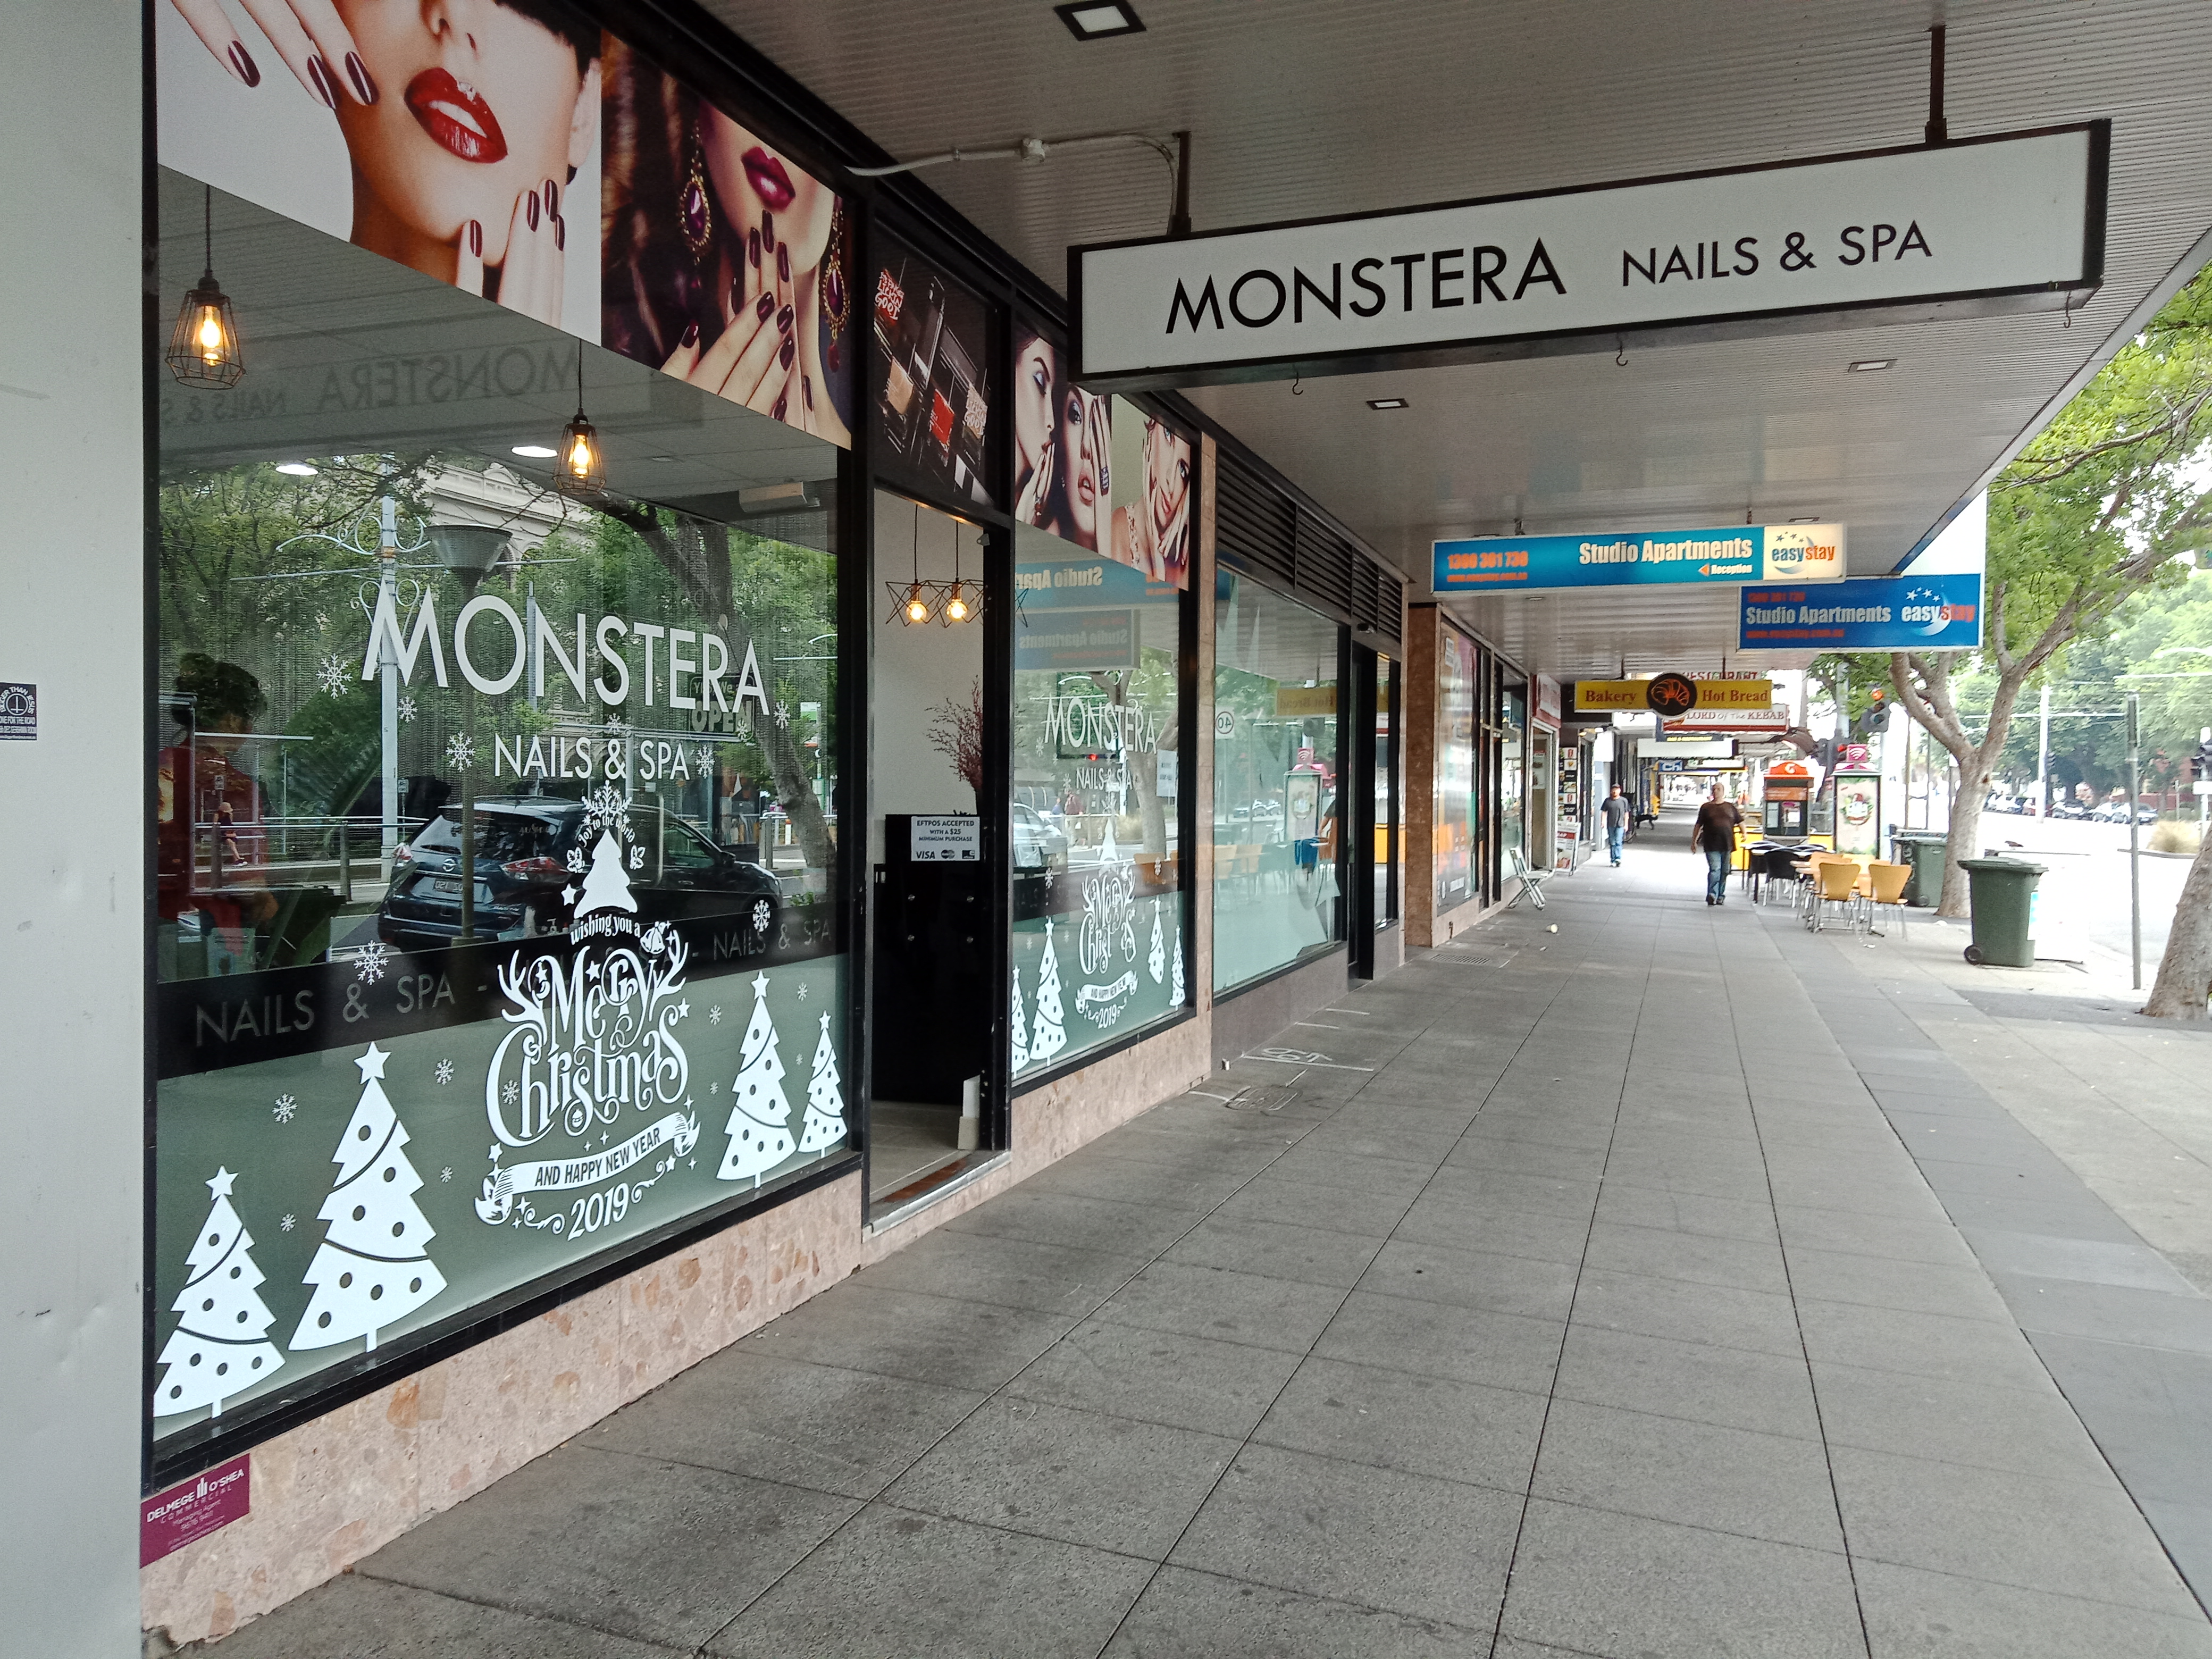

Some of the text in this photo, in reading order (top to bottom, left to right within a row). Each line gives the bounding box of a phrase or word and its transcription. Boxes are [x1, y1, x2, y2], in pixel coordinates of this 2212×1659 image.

[1166, 220, 1932, 334] MONSTERA NAILS & SPA
[1579, 538, 1753, 565] Studio Apartments
[1772, 544, 1836, 563] easystay
[1711, 564, 1753, 576] Reception
[1746, 605, 1891, 625] Studio Apartments
[1901, 604, 1975, 623] easystay
[362, 578, 769, 715] MONSTERA
[9, 686, 29, 696] THAN
[1585, 690, 1637, 705] Bakery
[1703, 690, 1768, 702] Hot Bread
[692, 700, 752, 732] OPEN
[1044, 693, 1157, 755] MONSTERA
[495, 733, 690, 781] NAILS & SPA
[1076, 767, 1104, 791] NAILS
[578, 814, 635, 848] Joy to the world
[571, 913, 641, 945] wishing you a
[803, 920, 832, 945] SPA
[196, 989, 315, 1046] NAILS
[342, 983, 369, 1023] &
[396, 971, 455, 1013] SPA
[527, 945, 664, 1055] Merry
[1098, 1004, 1117, 1029] 2019
[486, 1005, 689, 1146] Christmas
[534, 1127, 660, 1186] AND HAPPY NEW YEAR
[567, 1183, 629, 1241] 2019
[147, 1492, 195, 1522] DELMEGE
[208, 1469, 245, 1492] O'SHEA
[160, 1485, 232, 1524] COMMERCIAL
